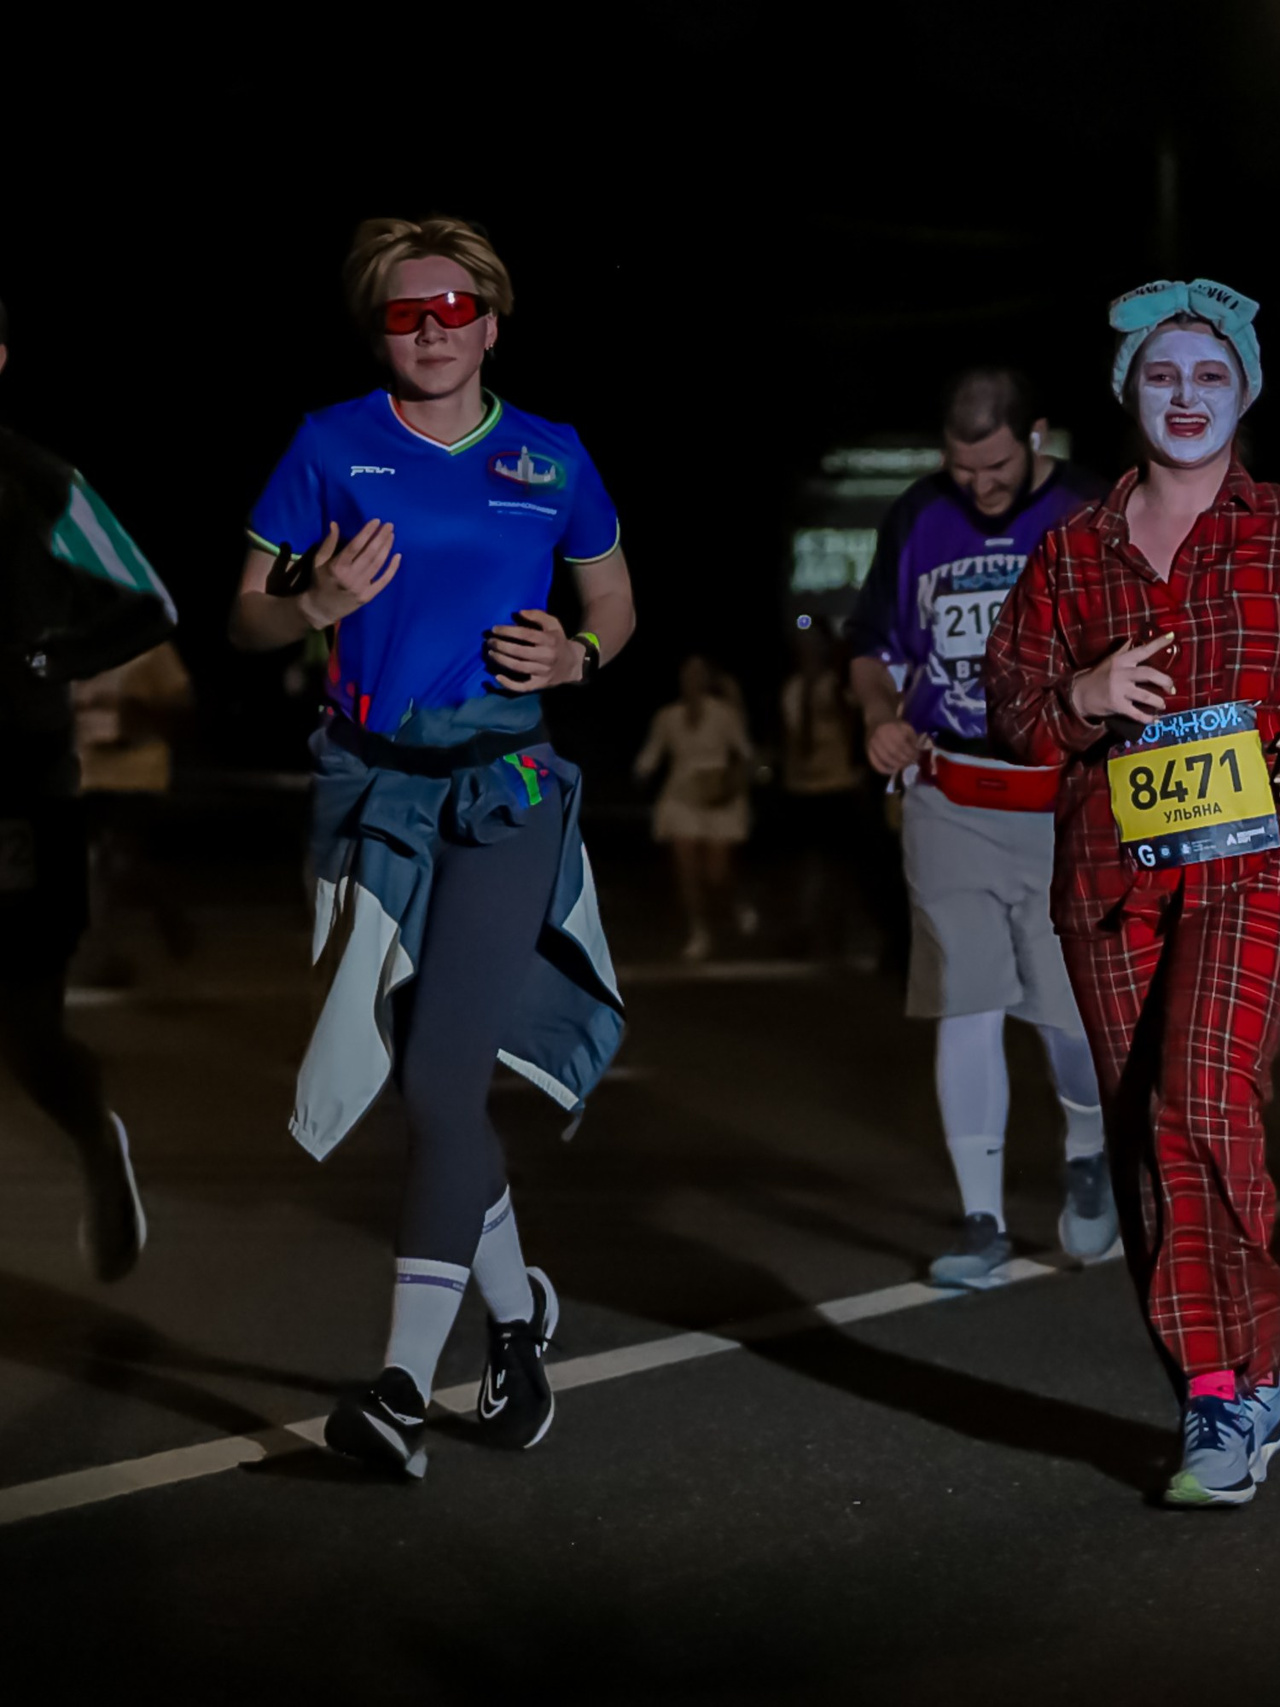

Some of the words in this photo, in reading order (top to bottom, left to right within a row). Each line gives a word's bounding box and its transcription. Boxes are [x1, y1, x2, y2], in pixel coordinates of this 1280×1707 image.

[1125, 702, 1242, 748] ОЧНОЙ
[1129, 748, 1243, 811] 8471
[1163, 802, 1222, 823] УЛЬЯНА
[1138, 844, 1156, 868] G
